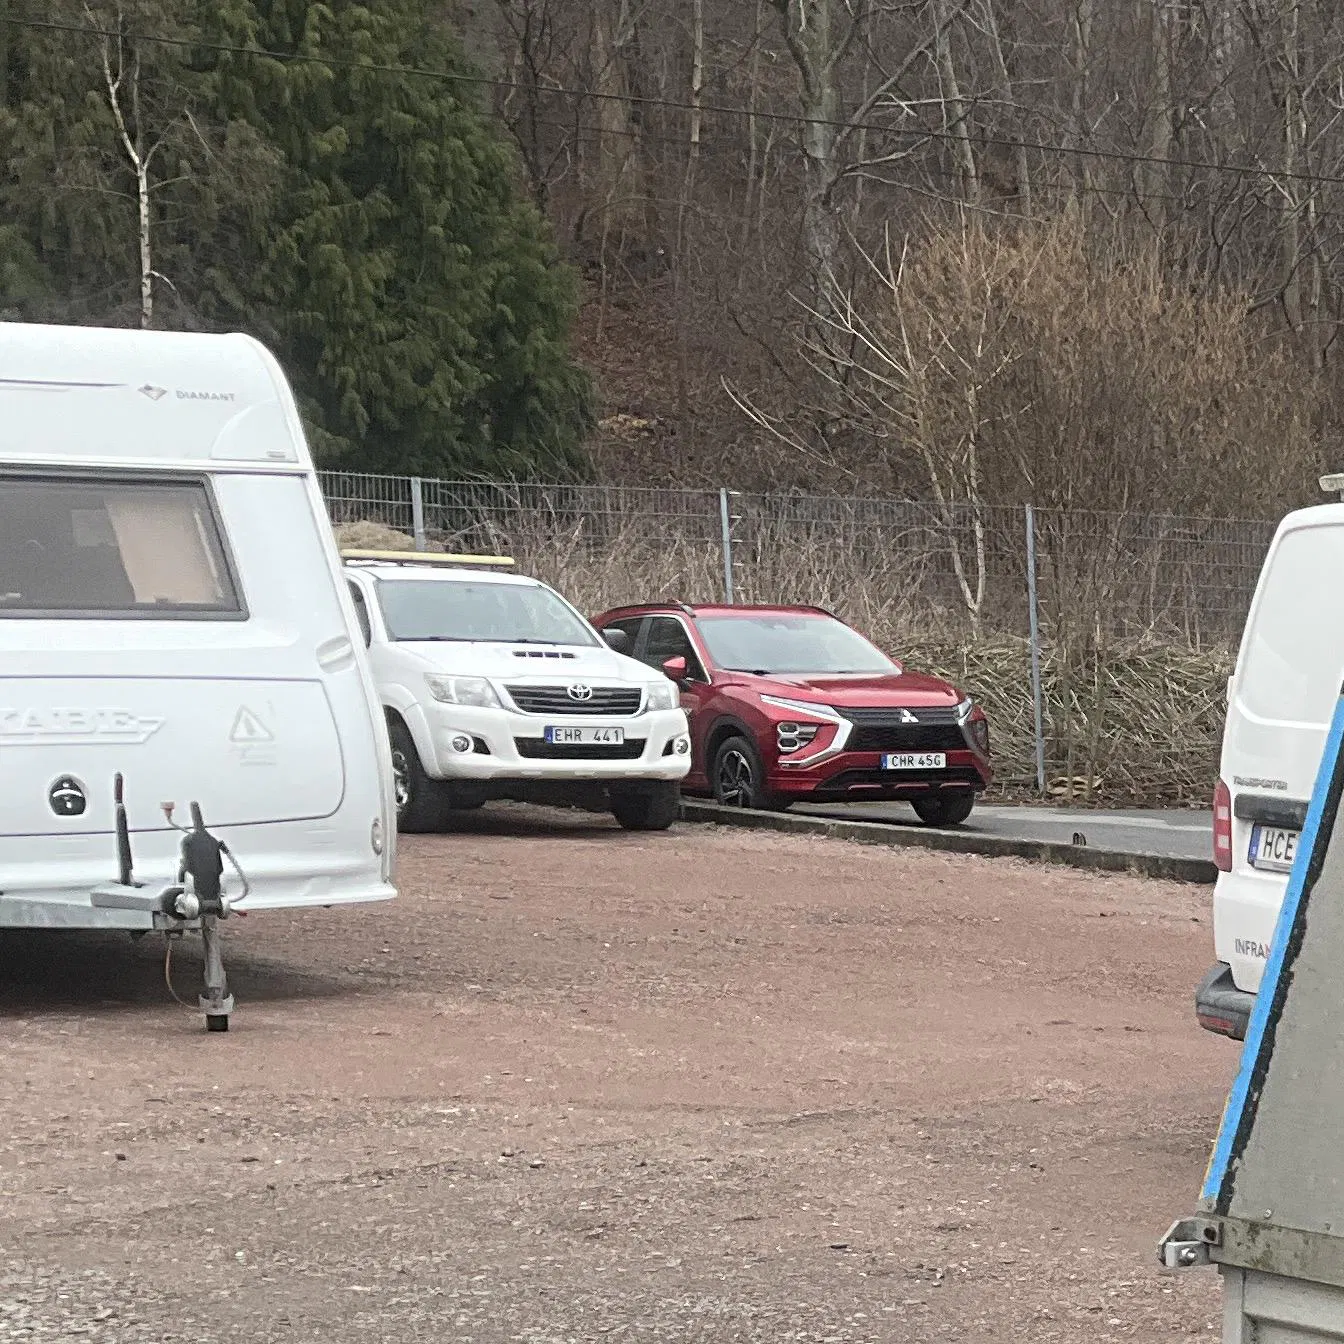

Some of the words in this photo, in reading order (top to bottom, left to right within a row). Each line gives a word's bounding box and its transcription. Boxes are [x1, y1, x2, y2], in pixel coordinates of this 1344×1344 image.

[175, 389, 236, 402] DIAMANT
[554, 728, 582, 742] EHR
[593, 729, 620, 743] 441
[891, 755, 915, 768] CHR
[1262, 829, 1297, 861] HCE
